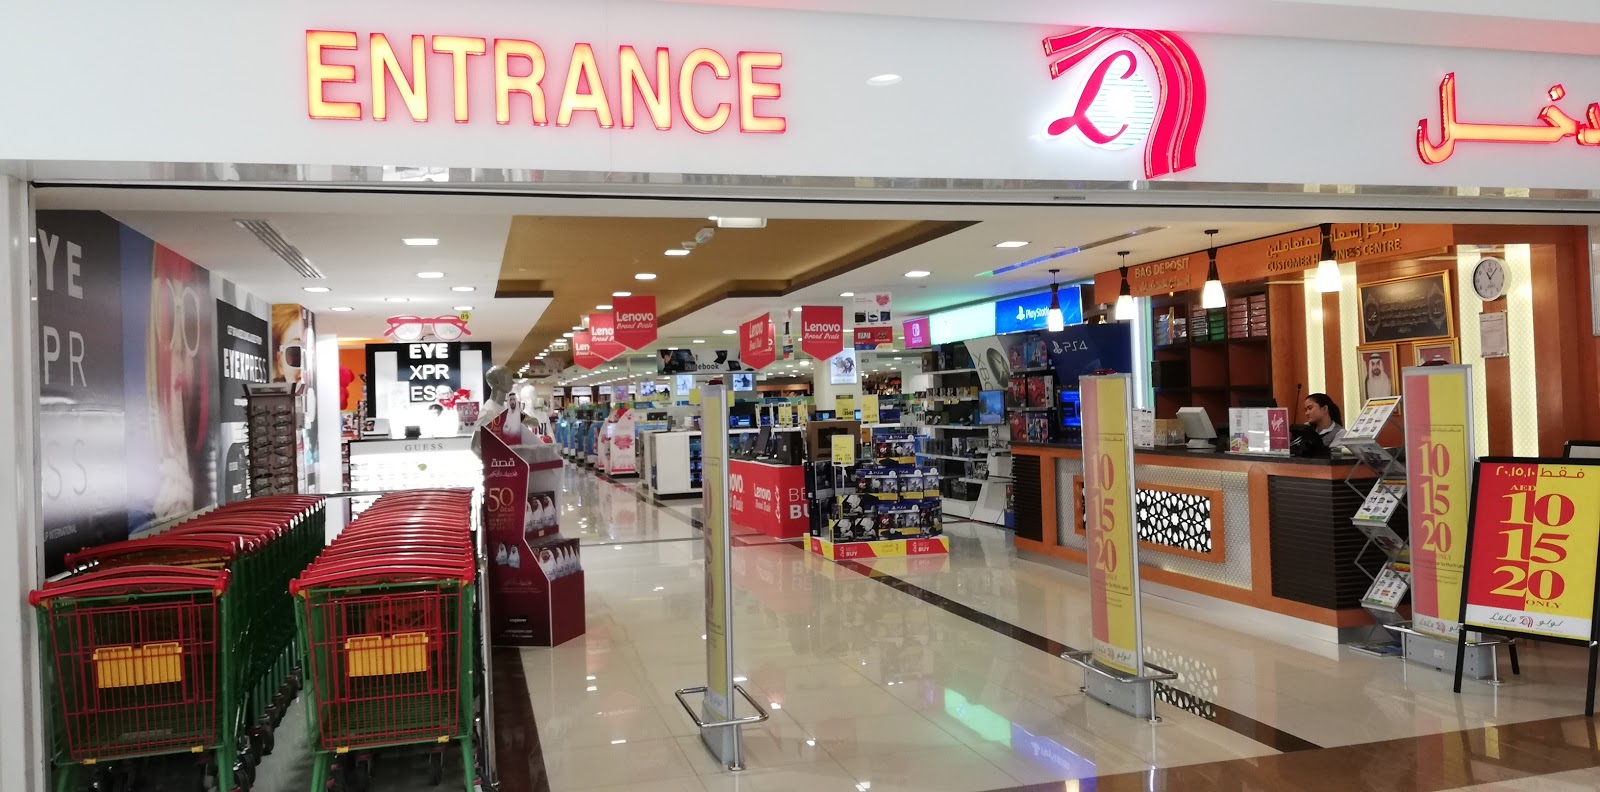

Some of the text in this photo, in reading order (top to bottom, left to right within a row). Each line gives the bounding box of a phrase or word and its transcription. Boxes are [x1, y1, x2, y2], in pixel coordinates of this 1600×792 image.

[305, 29, 787, 134] ENTRANCE
[38, 229, 84, 300] YE
[1267, 256, 1312, 272] CUSTOMER
[1364, 239, 1402, 255] CENTRE
[1134, 257, 1190, 279] BAG DEPOSIT
[616, 311, 654, 322] Lenovo
[591, 326, 614, 336] Leno
[616, 322, 636, 330] Brand
[804, 321, 841, 332] Lenovo
[804, 332, 840, 340] Brand Deals
[409, 343, 449, 359] EYE
[575, 342, 590, 351] Len
[1062, 340, 1088, 352] PS4
[43, 325, 88, 388] PR
[223, 347, 267, 384] EYEXPRESS
[410, 364, 450, 381] XPR
[685, 361, 719, 371] Notebook
[411, 385, 436, 402] ES
[405, 443, 444, 452] GUESS
[491, 457, 516, 468] قصة
[1417, 442, 1450, 478] 10
[46, 439, 88, 501] SS
[1090, 453, 1115, 491] 10
[1539, 466, 1585, 479] فقط
[487, 487, 515, 512] 50
[753, 483, 771, 501] Lenovo
[789, 486, 806, 502] BE
[1419, 481, 1450, 516] 15
[789, 503, 810, 520] BU
[1091, 493, 1116, 532] 15
[1500, 492, 1575, 527] 10
[1421, 519, 1452, 553] 20
[1095, 530, 1118, 573] 20
[1496, 528, 1570, 564] 15
[1489, 565, 1565, 601] 20
[1526, 600, 1563, 609] ONLY
